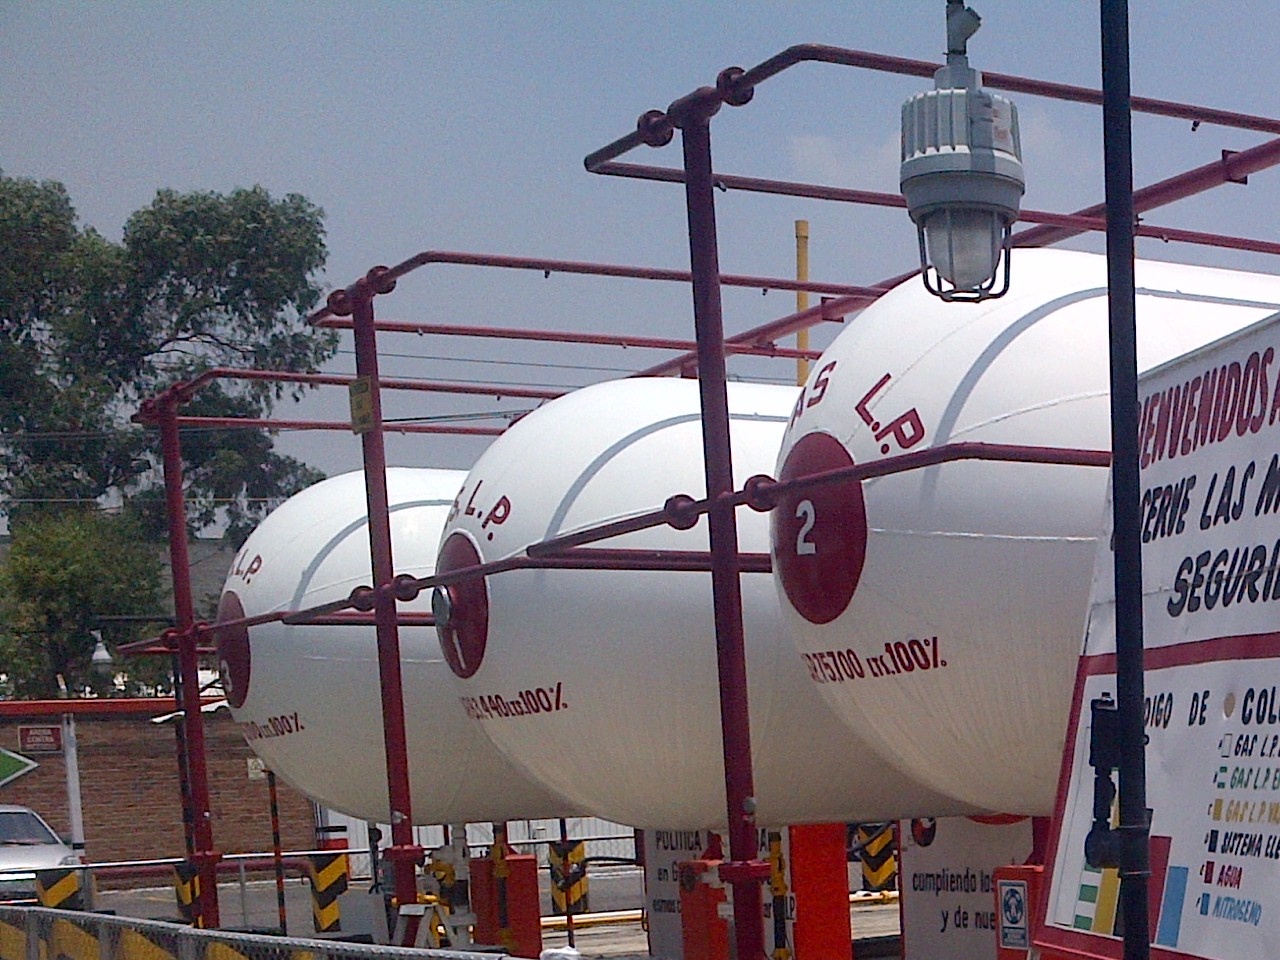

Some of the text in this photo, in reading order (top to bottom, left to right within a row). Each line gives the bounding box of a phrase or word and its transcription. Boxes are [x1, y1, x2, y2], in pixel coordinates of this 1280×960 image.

[855, 373, 925, 455] L.P.
[1137, 347, 1274, 469] IENVENIDOS
[1200, 461, 1255, 530] LAS
[796, 499, 817, 556] 2
[885, 636, 948, 675] 100%
[519, 682, 568, 713] 100%
[1144, 692, 1173, 730] DIGO
[1188, 690, 1210, 726] DE
[1234, 734, 1258, 757] GAS
[1230, 766, 1253, 790] GAS
[1225, 800, 1249, 822] GAS
[1221, 832, 1263, 857] SISTEMA
[913, 867, 977, 896] cumpliendo
[1217, 865, 1242, 889] AGUA
[940, 906, 995, 933] y de nue
